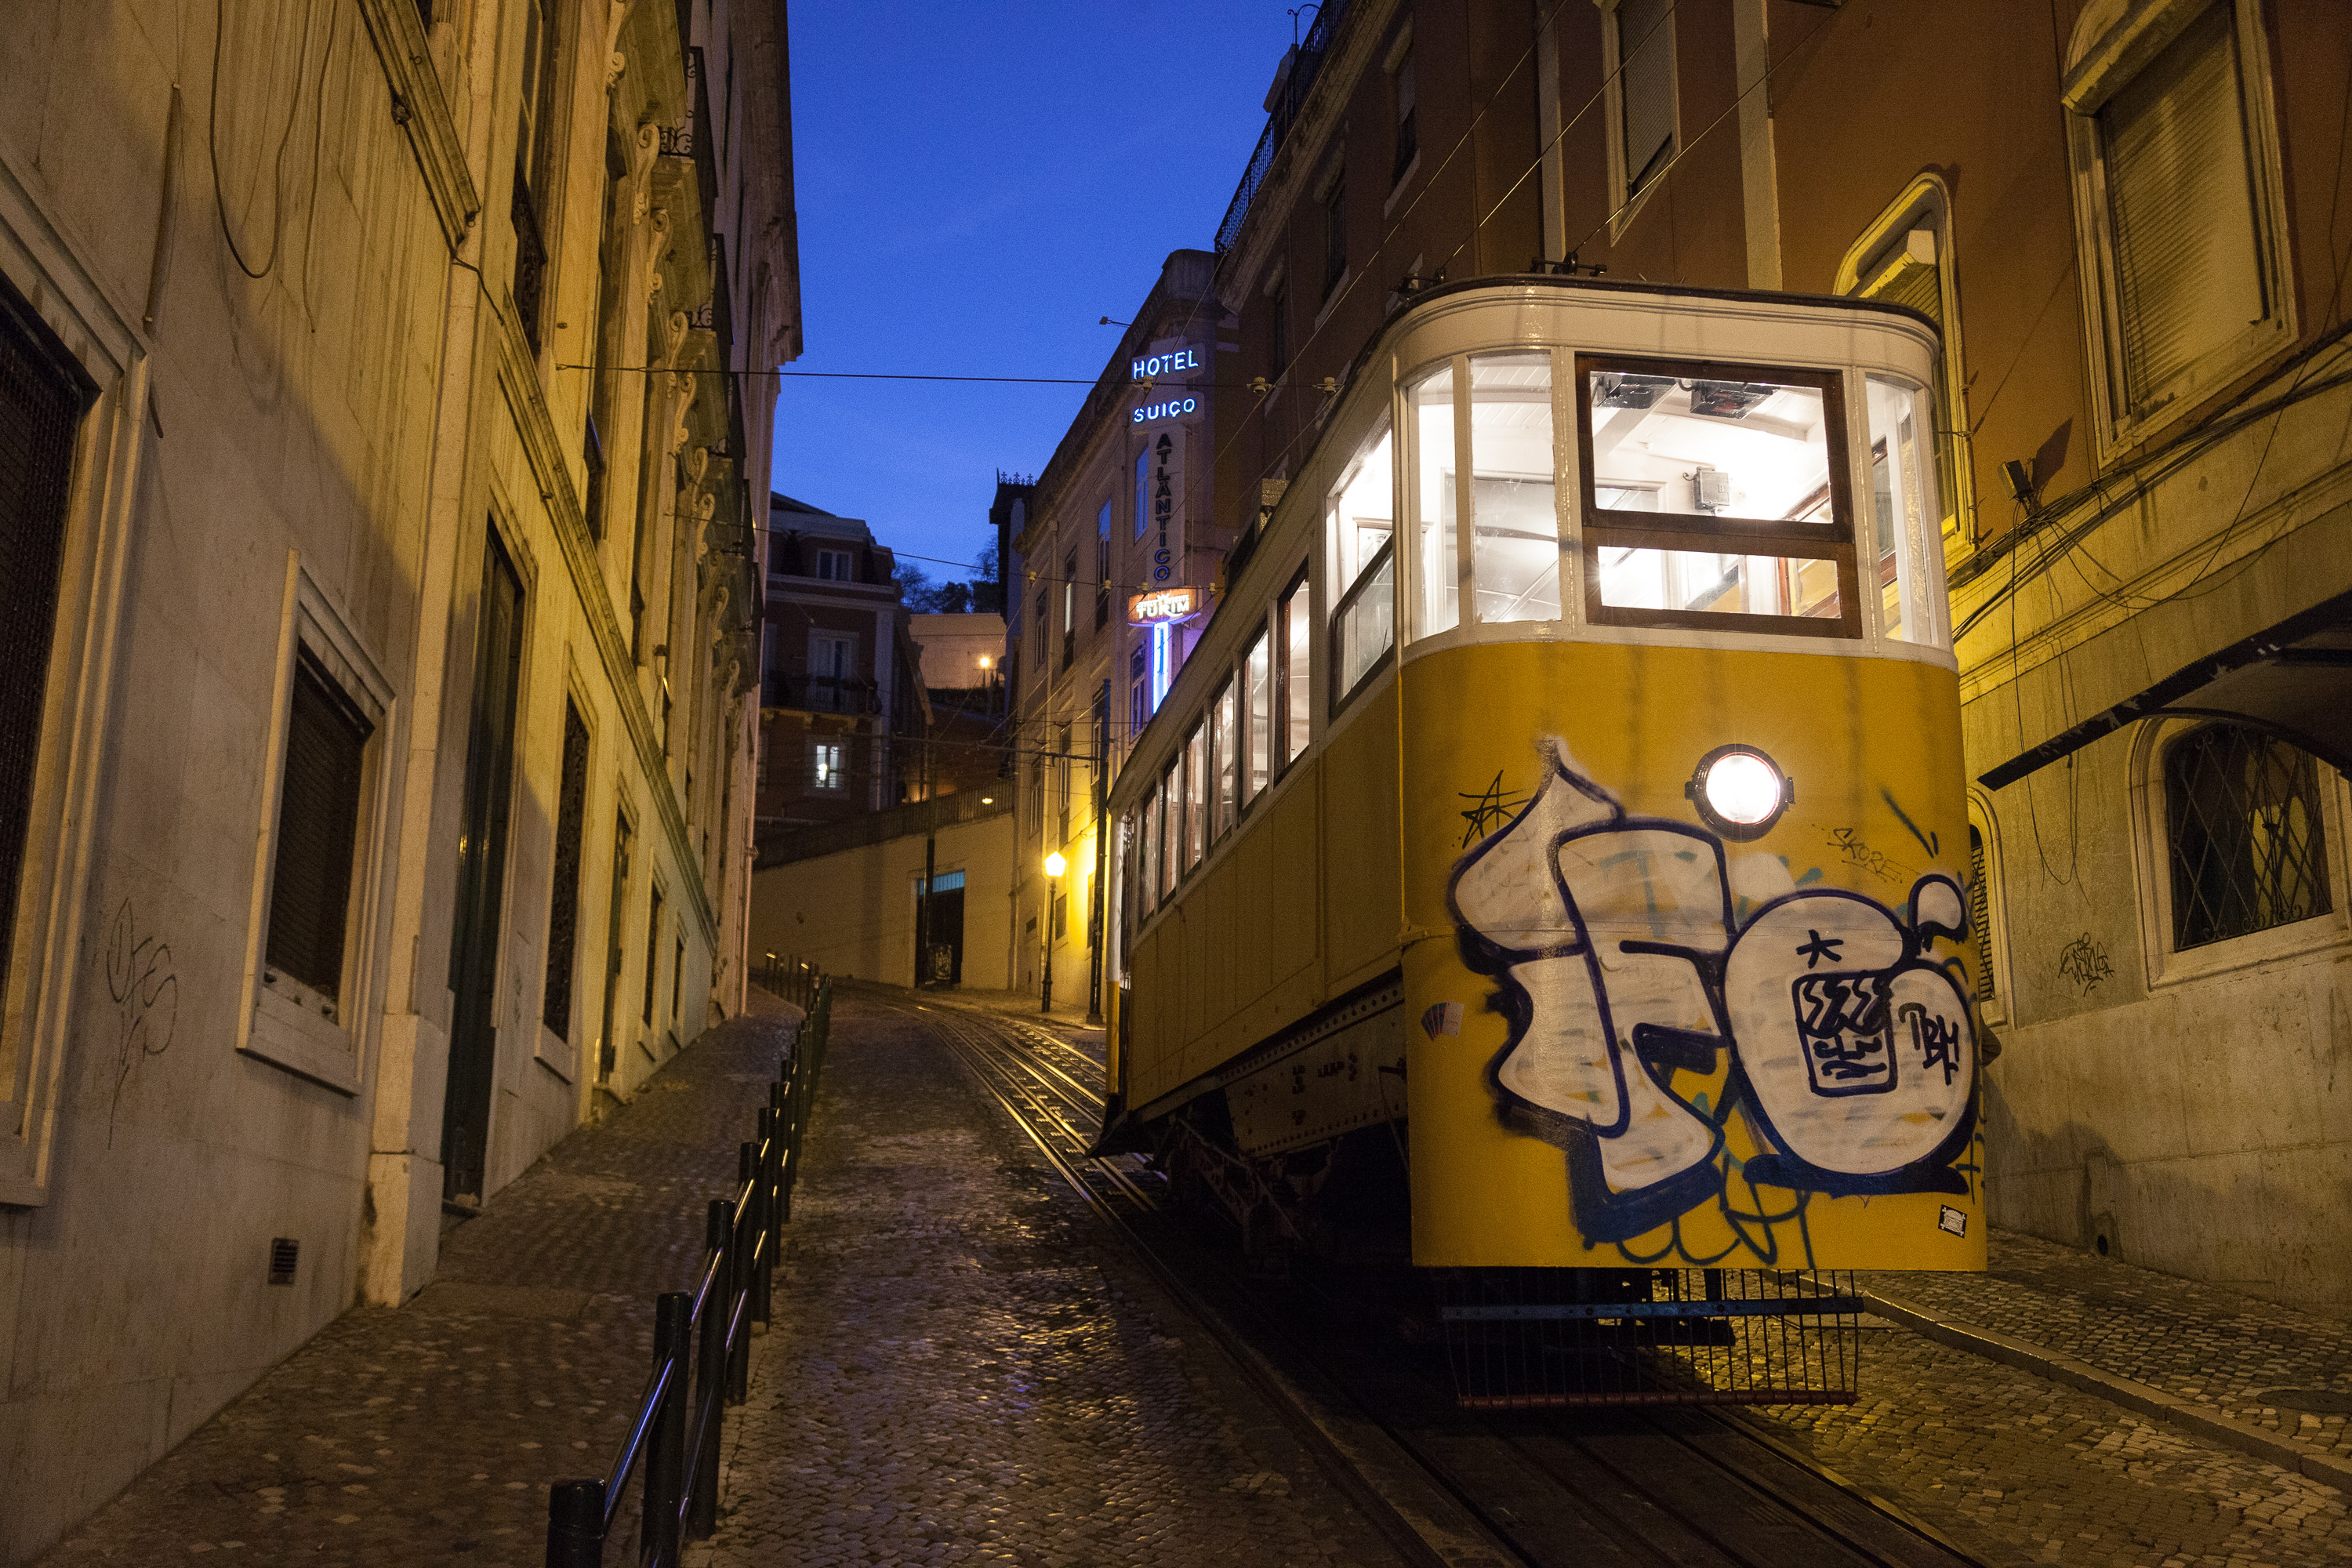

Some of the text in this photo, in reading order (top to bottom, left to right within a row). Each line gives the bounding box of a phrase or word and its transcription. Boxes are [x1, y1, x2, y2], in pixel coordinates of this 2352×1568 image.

[1133, 350, 1199, 379] HOTEL
[1134, 398, 1196, 423] SUIÇO
[1136, 601, 1189, 619] TURIM
